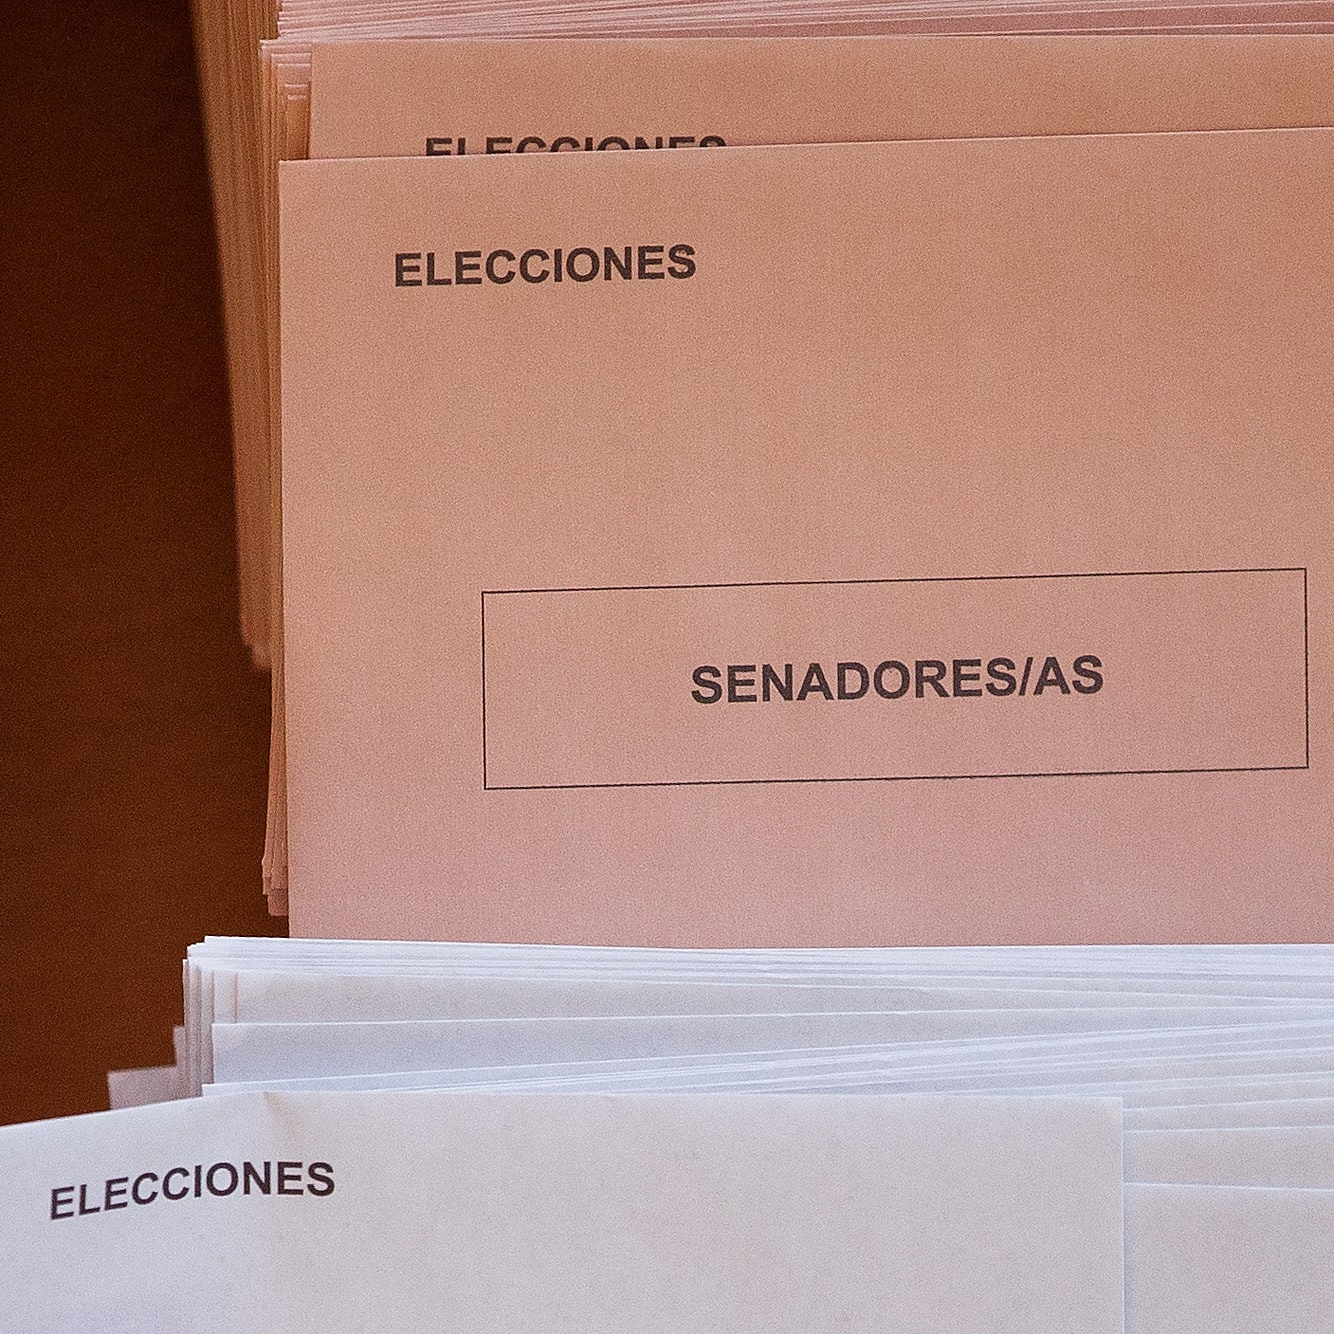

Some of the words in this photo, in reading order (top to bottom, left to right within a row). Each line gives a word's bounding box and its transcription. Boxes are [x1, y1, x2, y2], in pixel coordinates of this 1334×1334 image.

[394, 242, 697, 288] ELECCIONES
[690, 654, 1104, 705] SENADORES/AS
[49, 1159, 336, 1222] ELECCIONES
